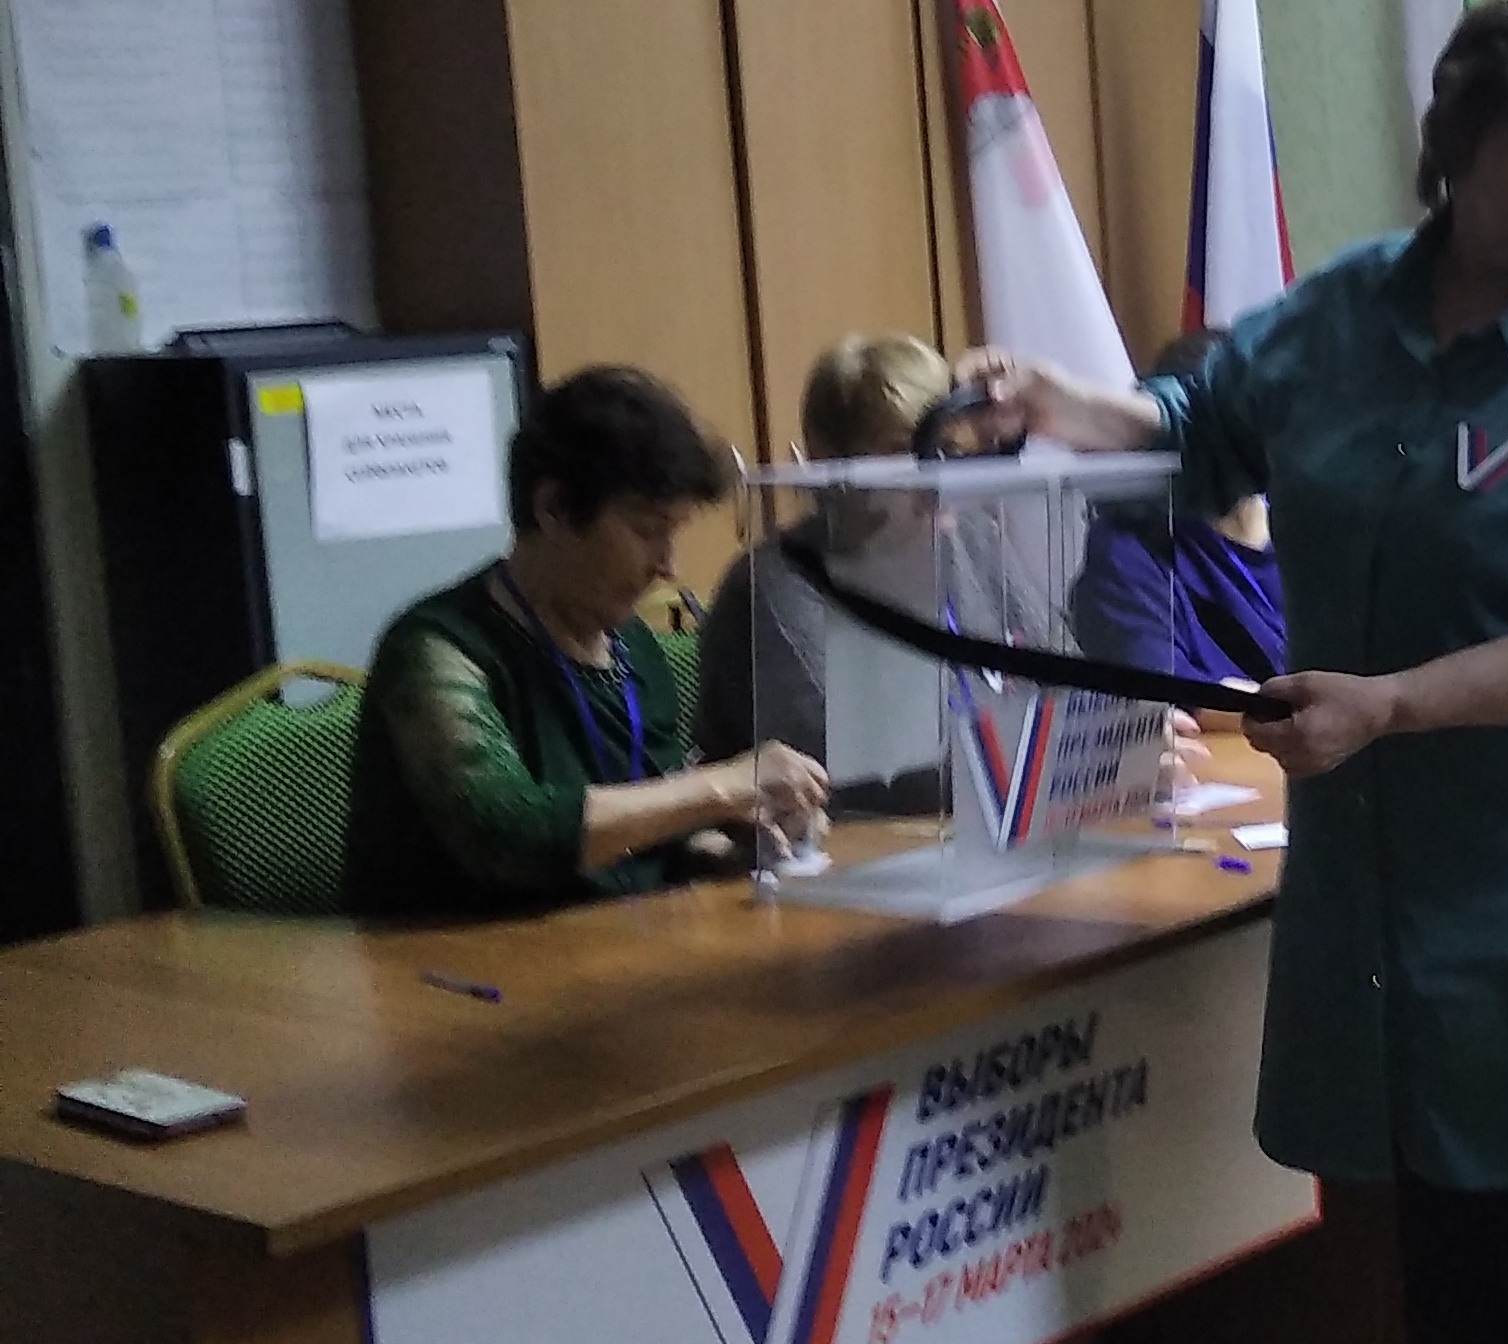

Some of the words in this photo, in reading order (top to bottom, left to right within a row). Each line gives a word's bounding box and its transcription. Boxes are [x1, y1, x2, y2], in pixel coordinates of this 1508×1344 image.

[916, 1010, 1099, 1124] ВЫБОРЫ
[897, 1057, 1148, 1203] ПРЕЗИДЕНТА
[878, 1162, 1050, 1286] РОССИИ
